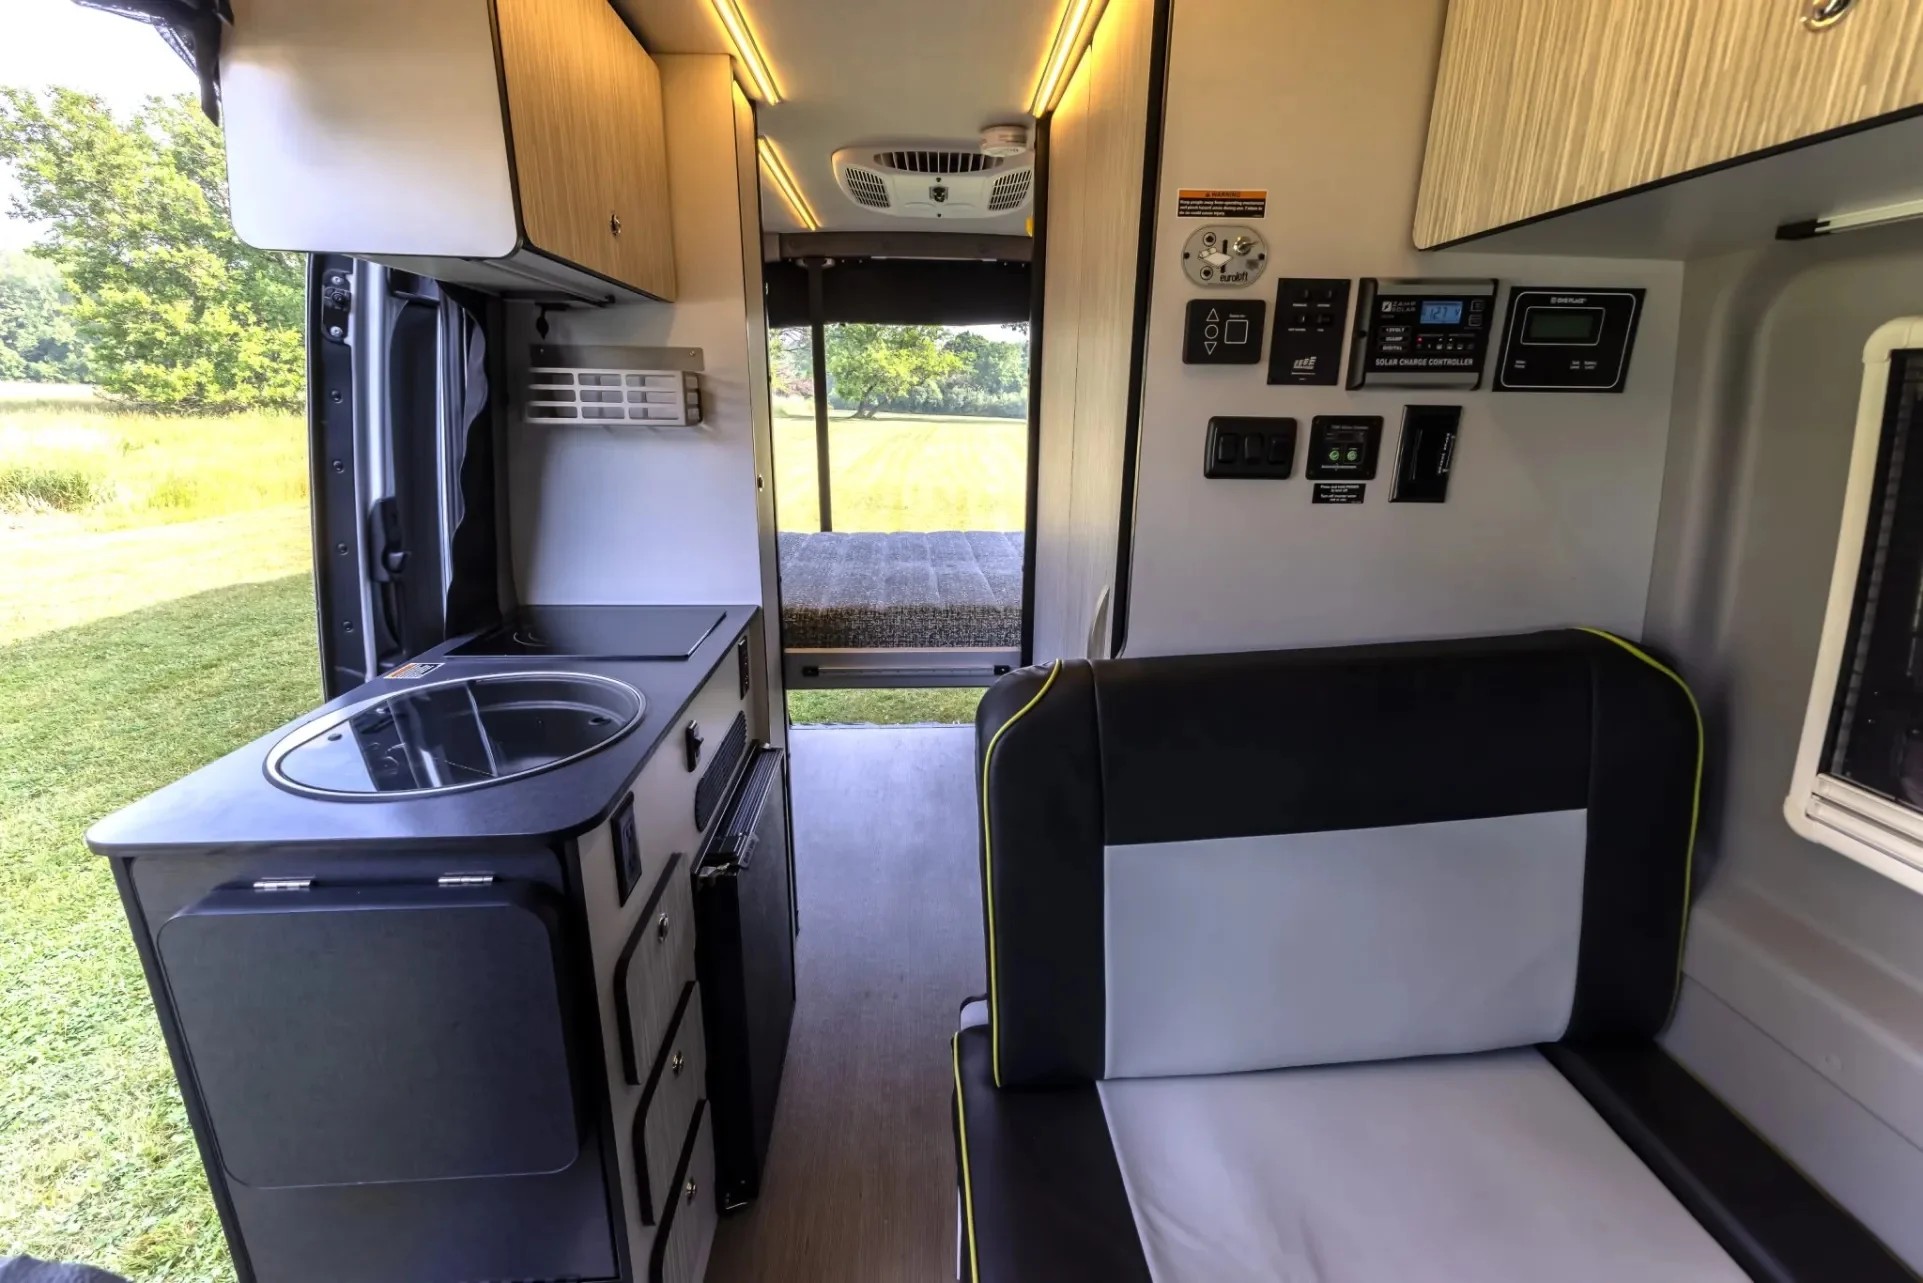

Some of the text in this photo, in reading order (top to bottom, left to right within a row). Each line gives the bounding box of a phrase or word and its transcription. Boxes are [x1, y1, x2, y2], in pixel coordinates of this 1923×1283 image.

[1220, 271, 1248, 282] euroloft
[1375, 358, 1473, 366] SOLAR CHARGE CONTROLLER
